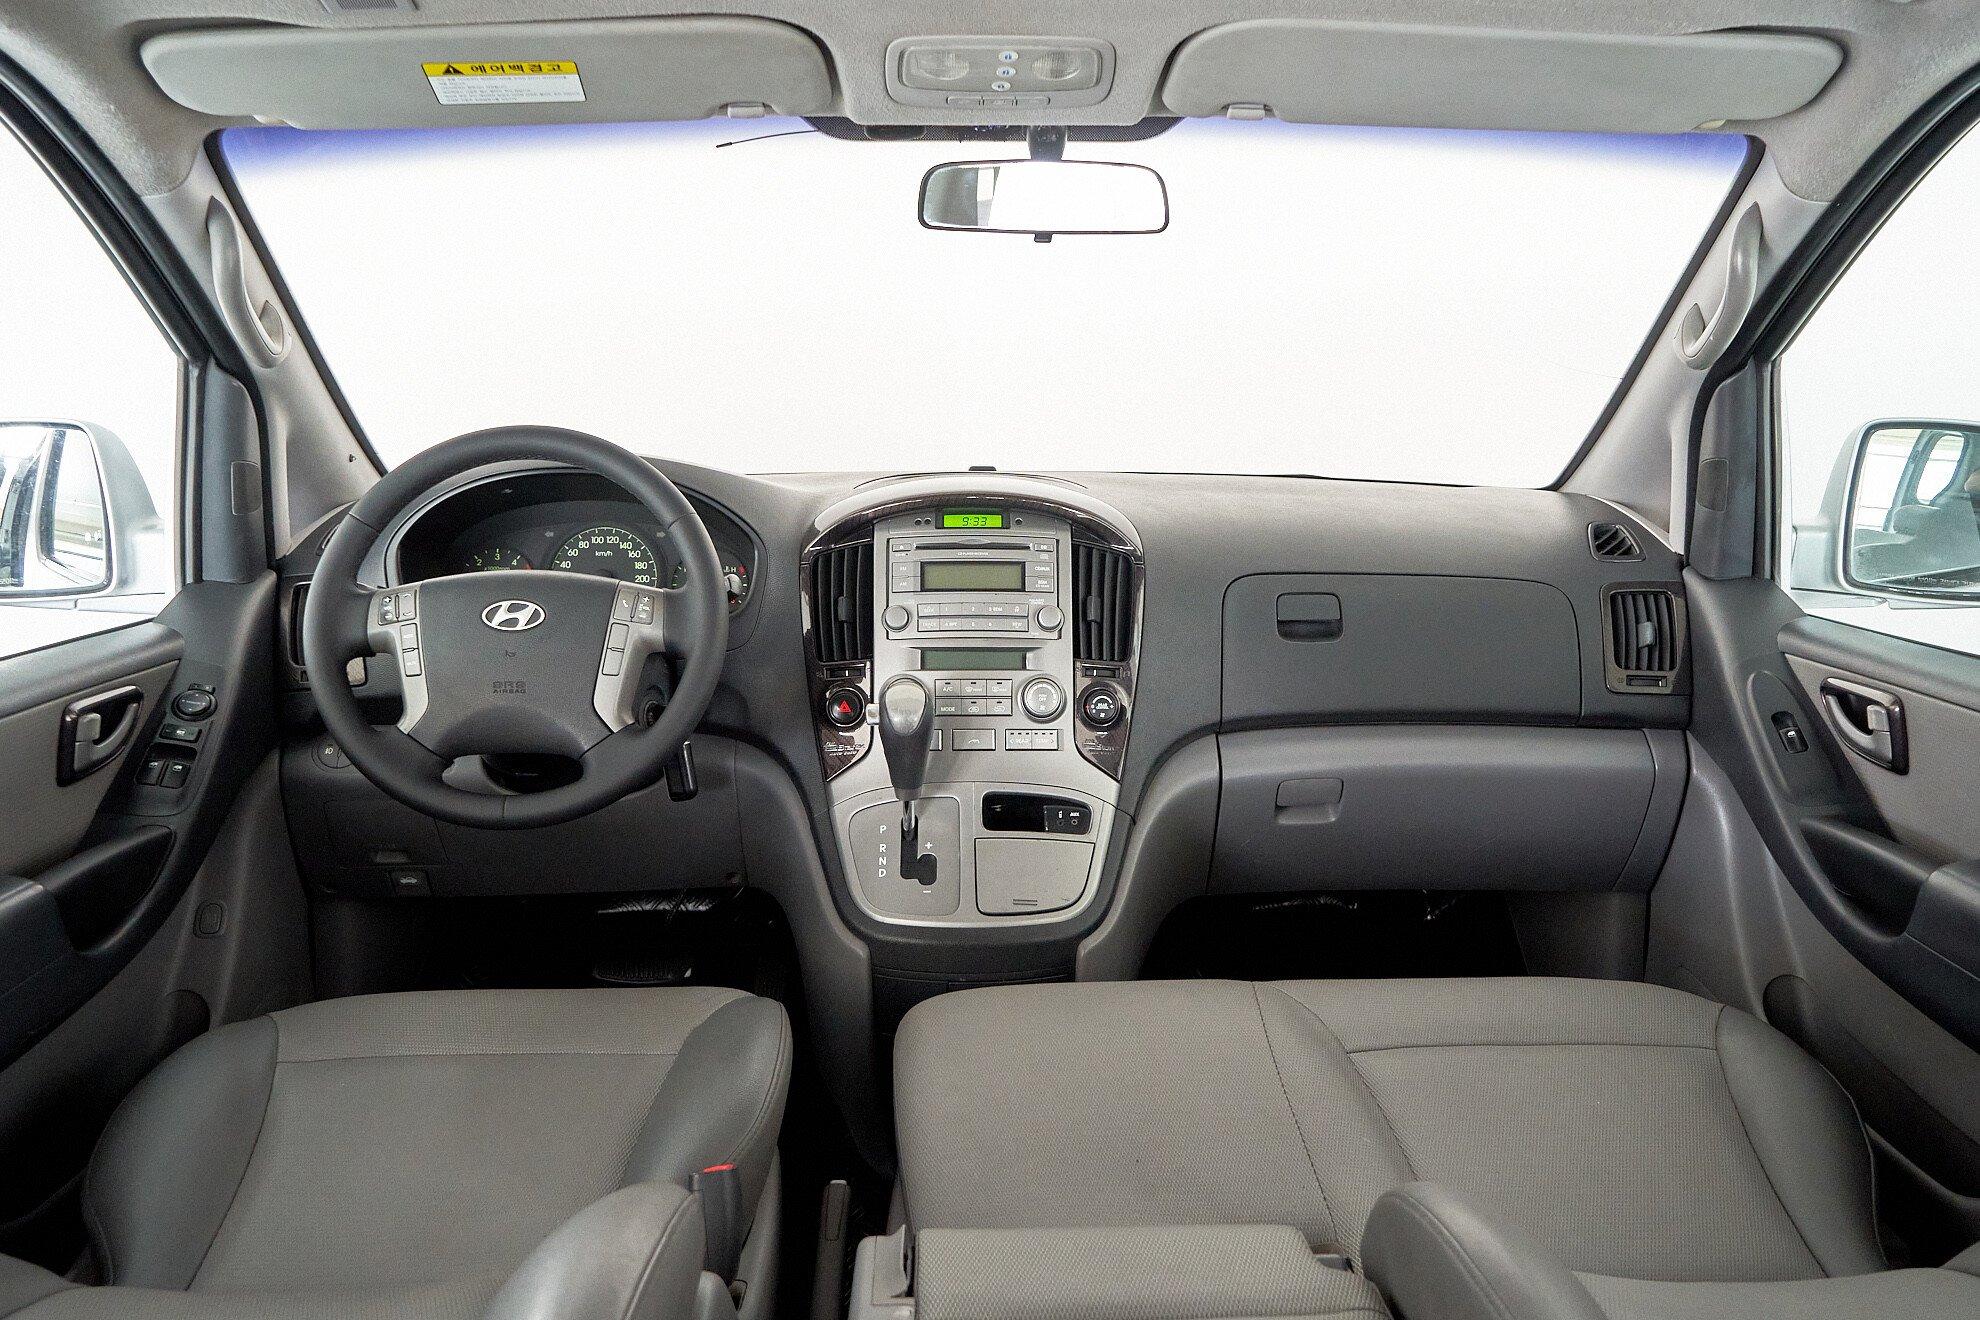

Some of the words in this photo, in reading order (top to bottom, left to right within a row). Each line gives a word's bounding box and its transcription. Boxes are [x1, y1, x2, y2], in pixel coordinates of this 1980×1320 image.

[962, 516, 988, 527] 9:33
[591, 536, 604, 544] 100
[606, 535, 619, 544] 120
[578, 540, 590, 549] 80
[619, 541, 633, 550] 140
[495, 553, 500, 561] 3
[567, 548, 579, 557] 60
[628, 549, 641, 558] 160
[476, 558, 483, 566] 2
[511, 558, 517, 566] 4
[560, 560, 571, 569] 40
[634, 561, 648, 570] 180
[634, 574, 650, 583] 200
[880, 824, 887, 834] P
[879, 843, 887, 853] R
[879, 856, 887, 866] N
[878, 868, 887, 878] D
